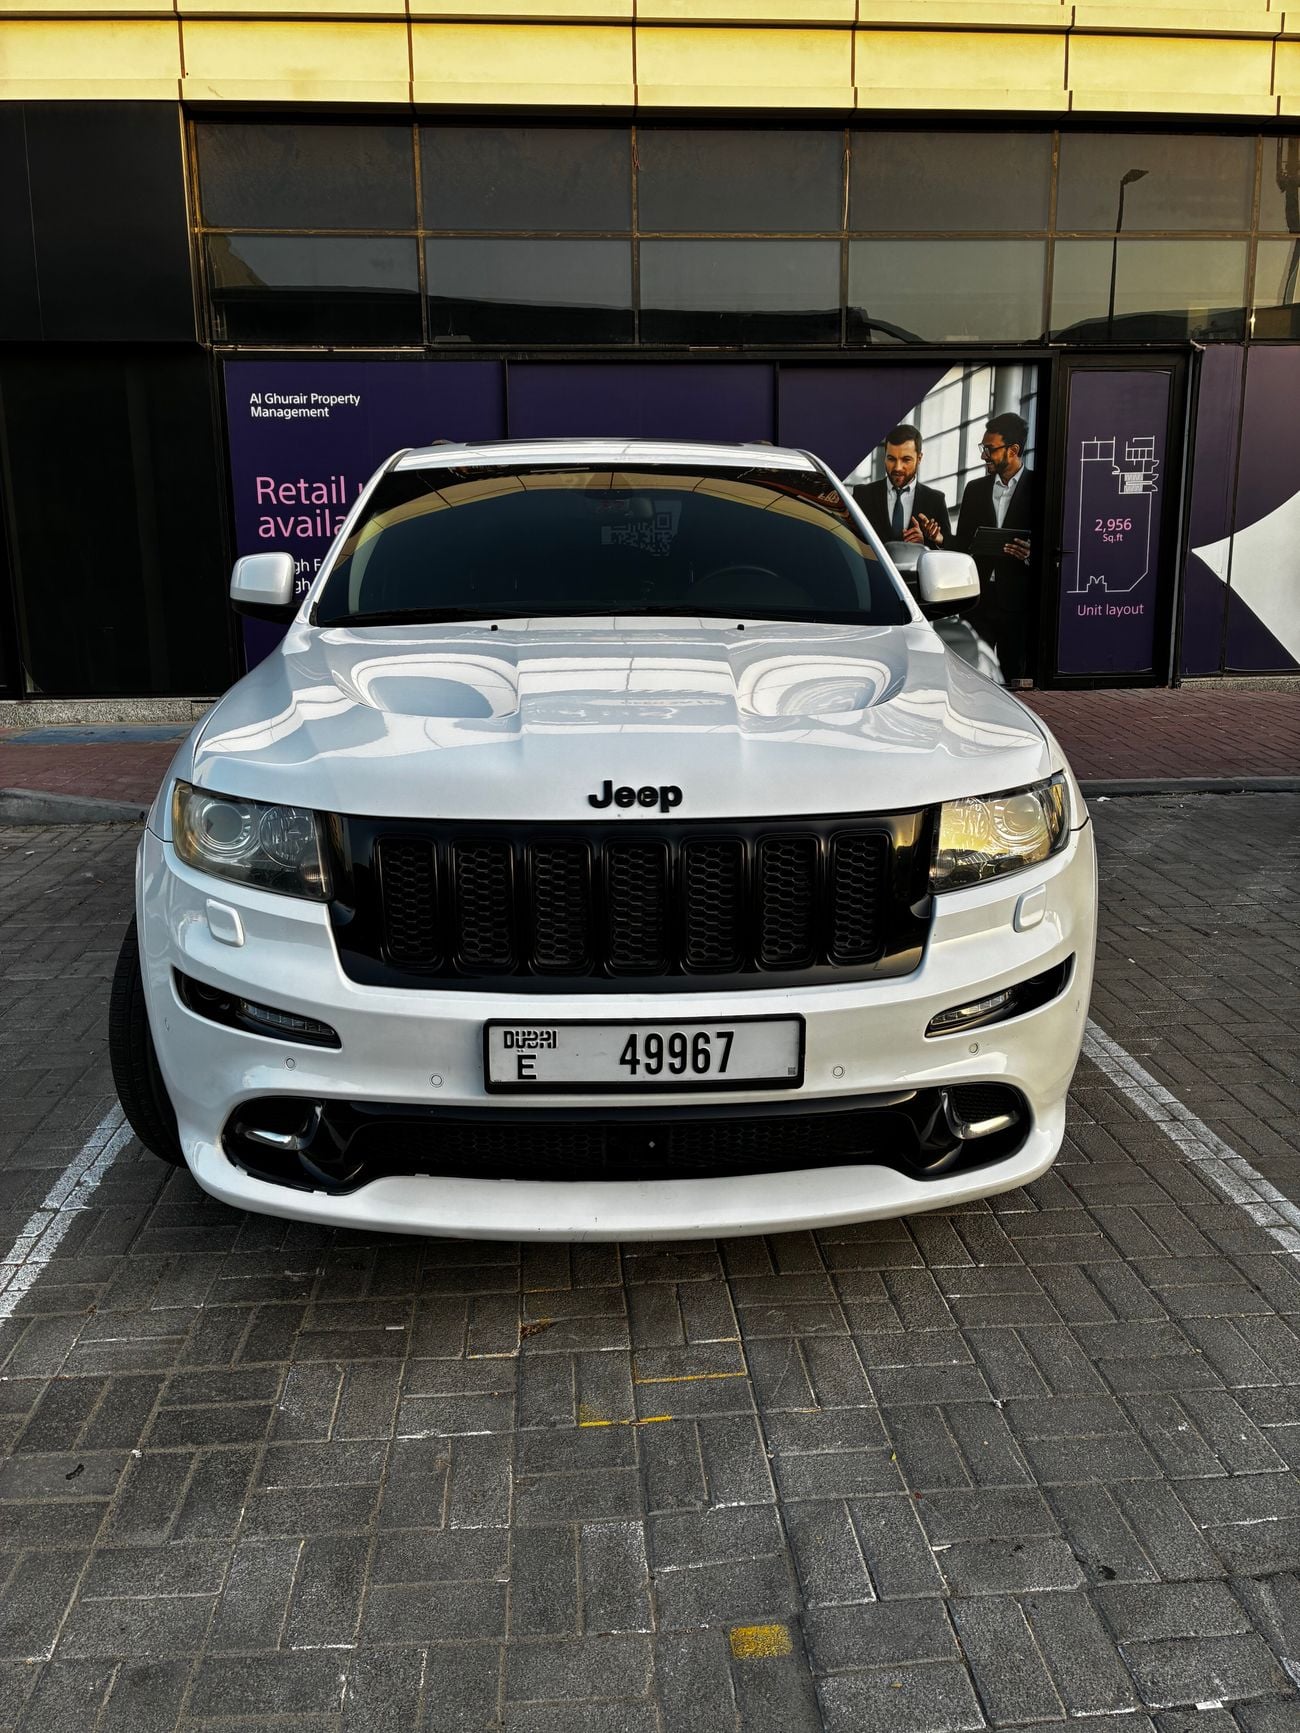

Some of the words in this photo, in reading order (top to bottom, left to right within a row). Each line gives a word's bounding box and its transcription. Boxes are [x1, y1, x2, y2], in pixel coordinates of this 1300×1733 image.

[250, 393, 262, 404] Al
[265, 393, 308, 405] Ghurair
[311, 393, 361, 406] Property
[251, 406, 330, 419] Management
[256, 475, 346, 505] Retail
[1095, 518, 1132, 533] 2,956
[1102, 533, 1124, 543] Sq.ft
[1077, 604, 1102, 616] Unit
[1106, 603, 1145, 618] layout
[588, 780, 683, 813] Jeep
[619, 1030, 735, 1076] 49967
[517, 1054, 537, 1080] E
